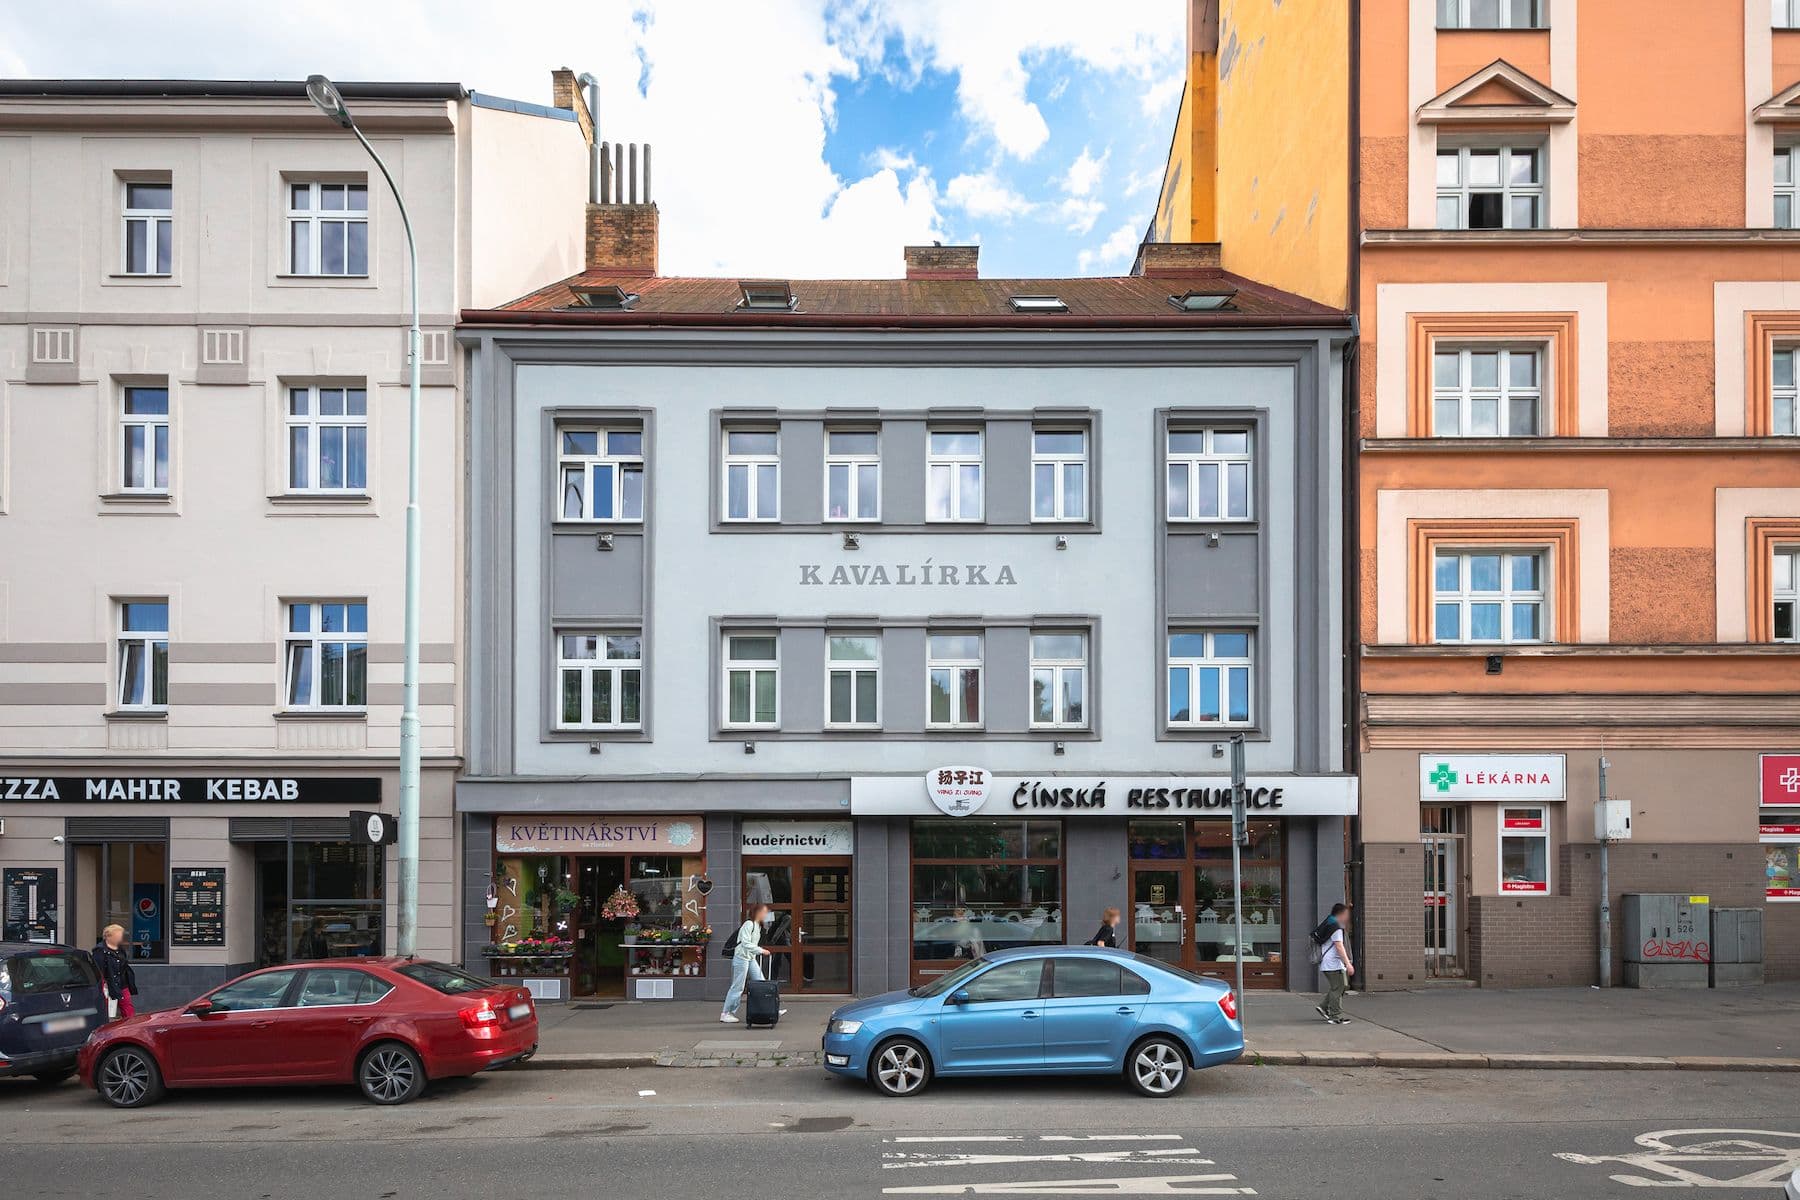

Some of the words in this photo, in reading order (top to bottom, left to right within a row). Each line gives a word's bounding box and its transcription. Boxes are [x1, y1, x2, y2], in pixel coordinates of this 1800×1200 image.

[799, 557, 1018, 586] KAVALÍRKA
[1465, 771, 1551, 784] LÉKÁRNA
[0, 779, 60, 800] ZZA
[85, 779, 181, 800] MAHIR
[206, 779, 299, 800] KEBAB
[1012, 781, 1106, 809] ČÍNSKÁ
[511, 822, 658, 841] KVĚTINÁŘSTVÍ
[743, 834, 827, 846] kadeřnictví
[1677, 925, 1694, 933] 526
